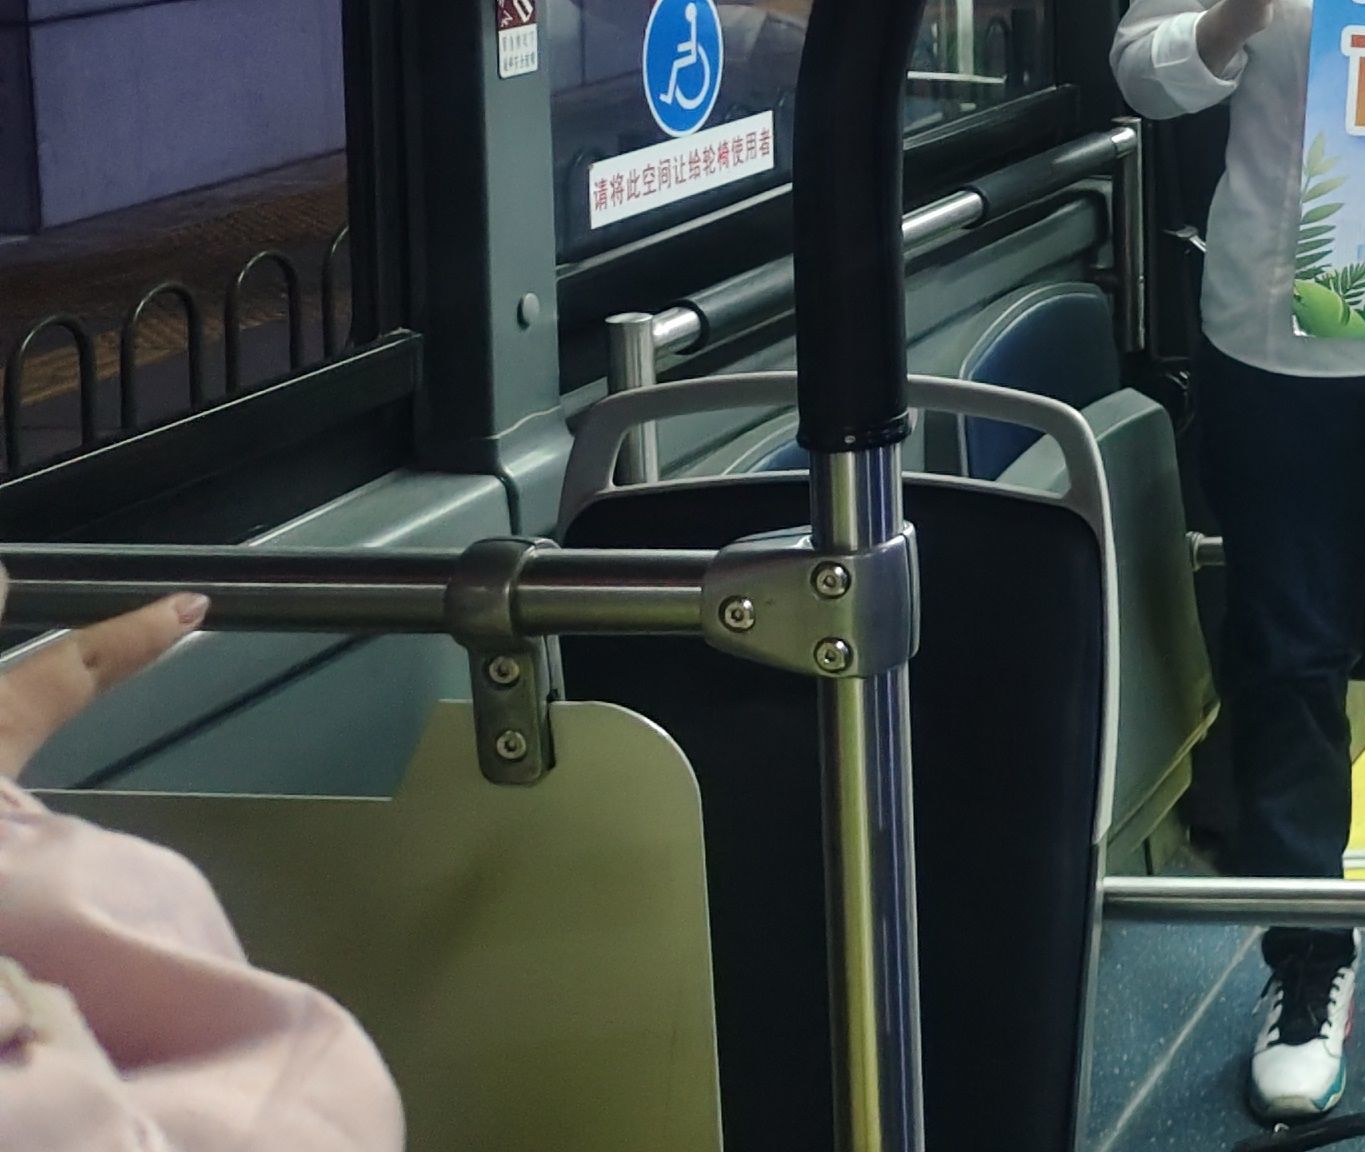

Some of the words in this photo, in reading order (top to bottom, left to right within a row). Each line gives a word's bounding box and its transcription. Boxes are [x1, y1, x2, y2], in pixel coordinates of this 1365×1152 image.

[593, 127, 771, 212] 请将此空间让给轮椅使用者
